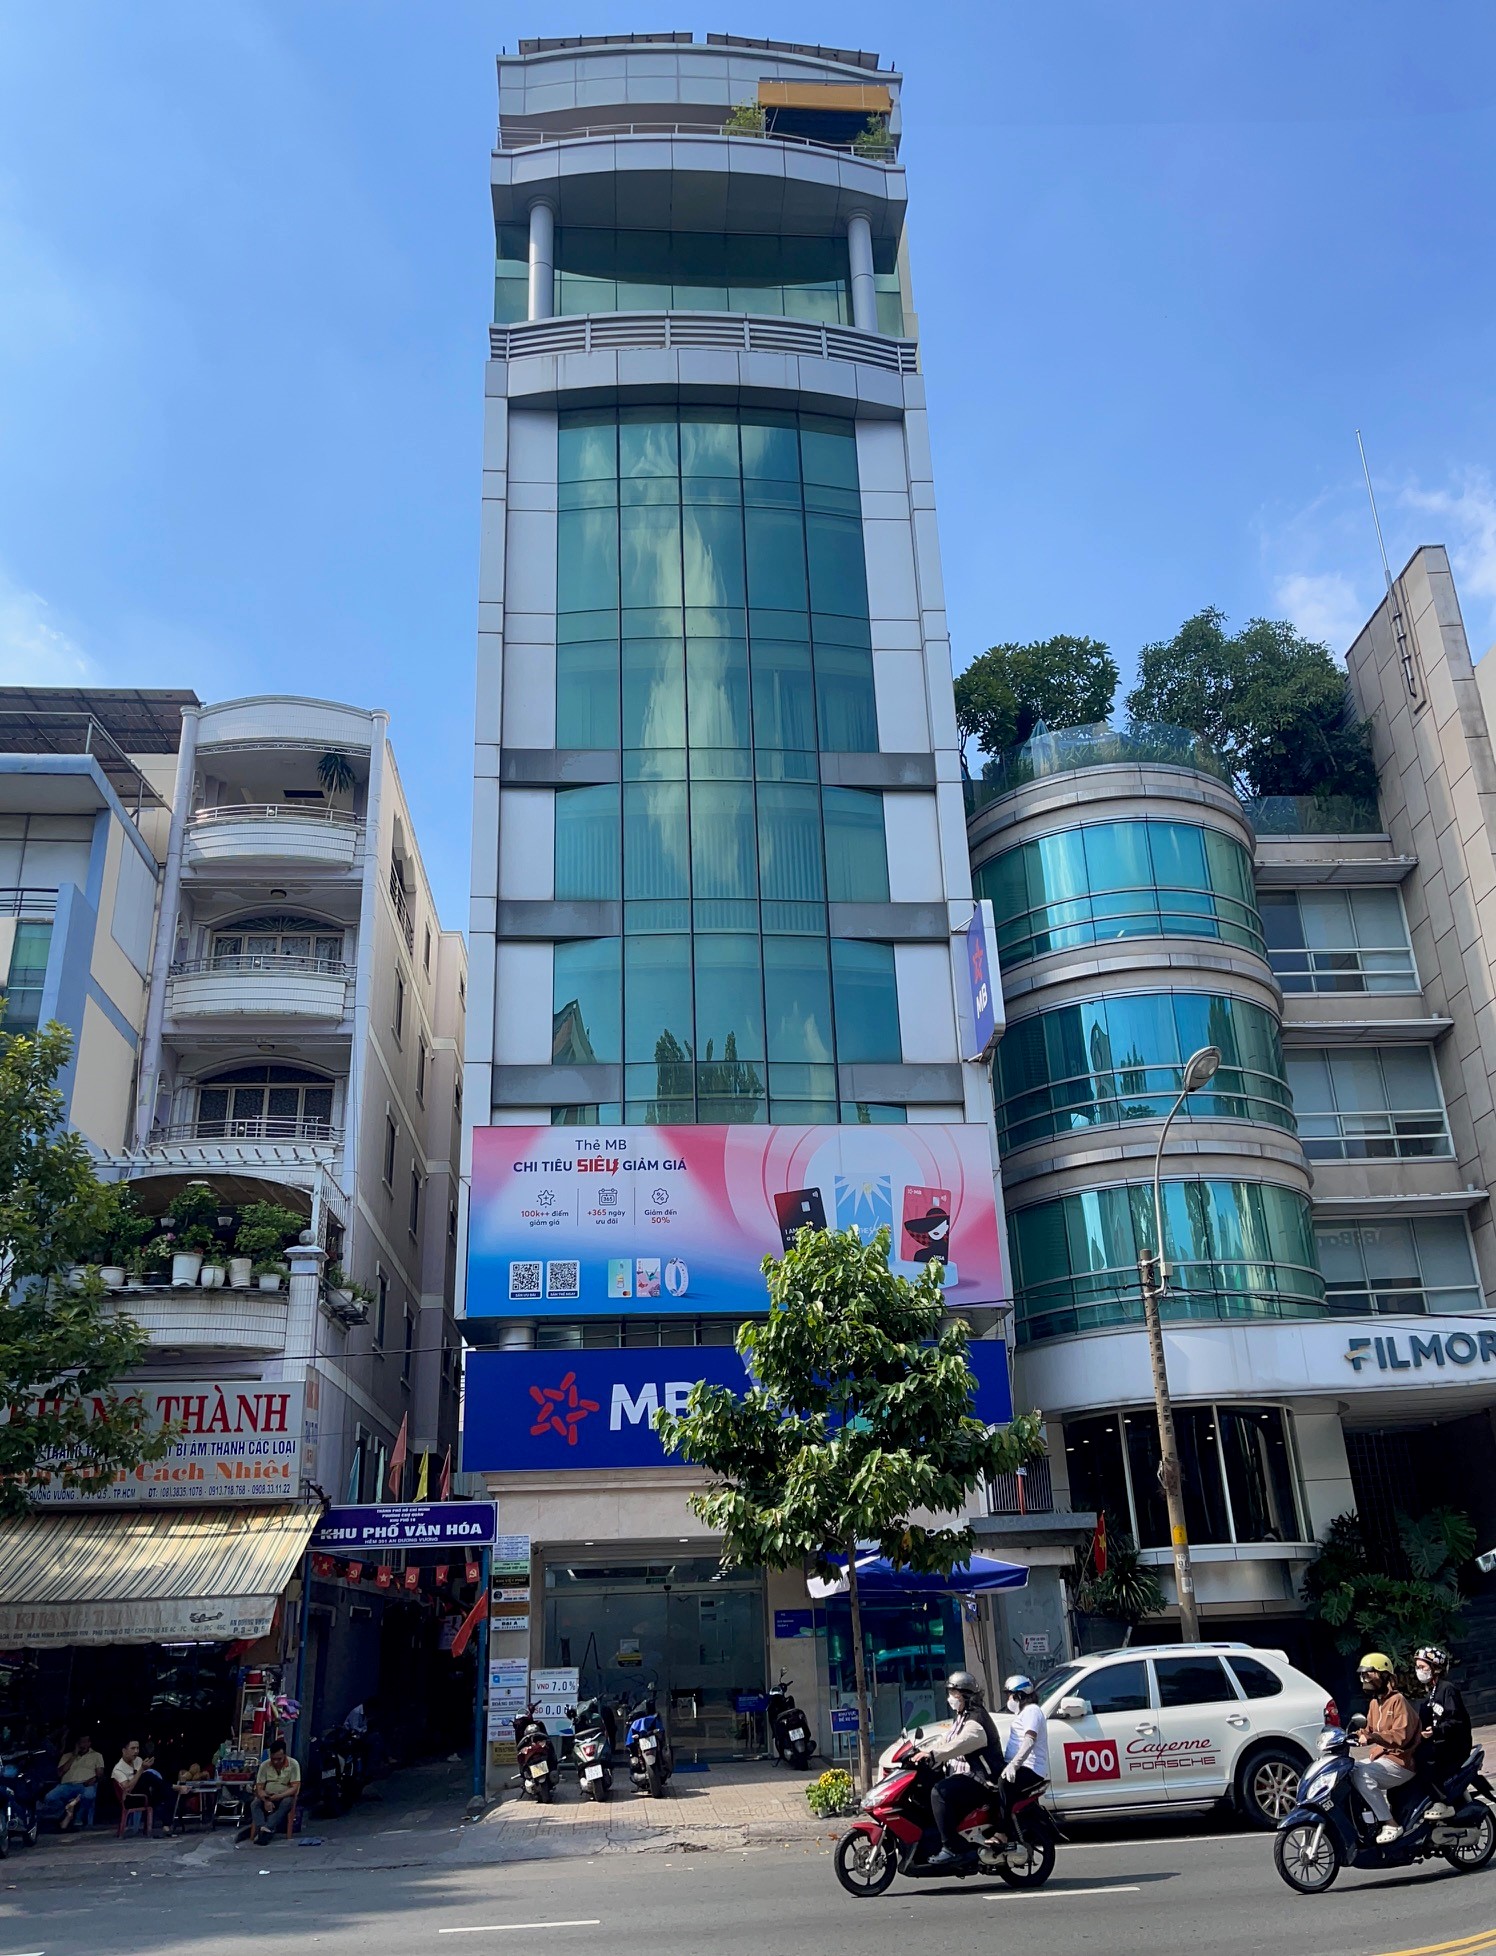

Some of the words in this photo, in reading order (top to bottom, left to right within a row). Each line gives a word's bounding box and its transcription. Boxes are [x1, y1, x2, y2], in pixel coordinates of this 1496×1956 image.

[976, 983, 988, 1019] MB
[575, 1139, 600, 1151] Thẻ
[605, 1139, 627, 1150] MB
[513, 1161, 538, 1172] CHI
[542, 1158, 572, 1172] TIÊU
[622, 1157, 659, 1171] GIẢM
[662, 1157, 687, 1171] GIÁ
[529, 1218, 548, 1227] giảm
[549, 1218, 560, 1227] giá
[156, 1384, 291, 1434] THÀNH
[176, 1441, 187, 1460] BỊ
[248, 1438, 269, 1455] CÁC
[273, 1440, 296, 1457] LOẠI
[135, 1461, 204, 1481] Cách
[214, 1459, 291, 1484] Nhiệt
[320, 1528, 357, 1540] KHU
[362, 1522, 399, 1538] PHỐ
[405, 1524, 441, 1537] VĂN
[446, 1521, 482, 1535] HÓA
[1126, 1738, 1212, 1760] Cayenne
[1070, 1749, 1115, 1774] 700
[1129, 1756, 1216, 1771] PORSCHE
